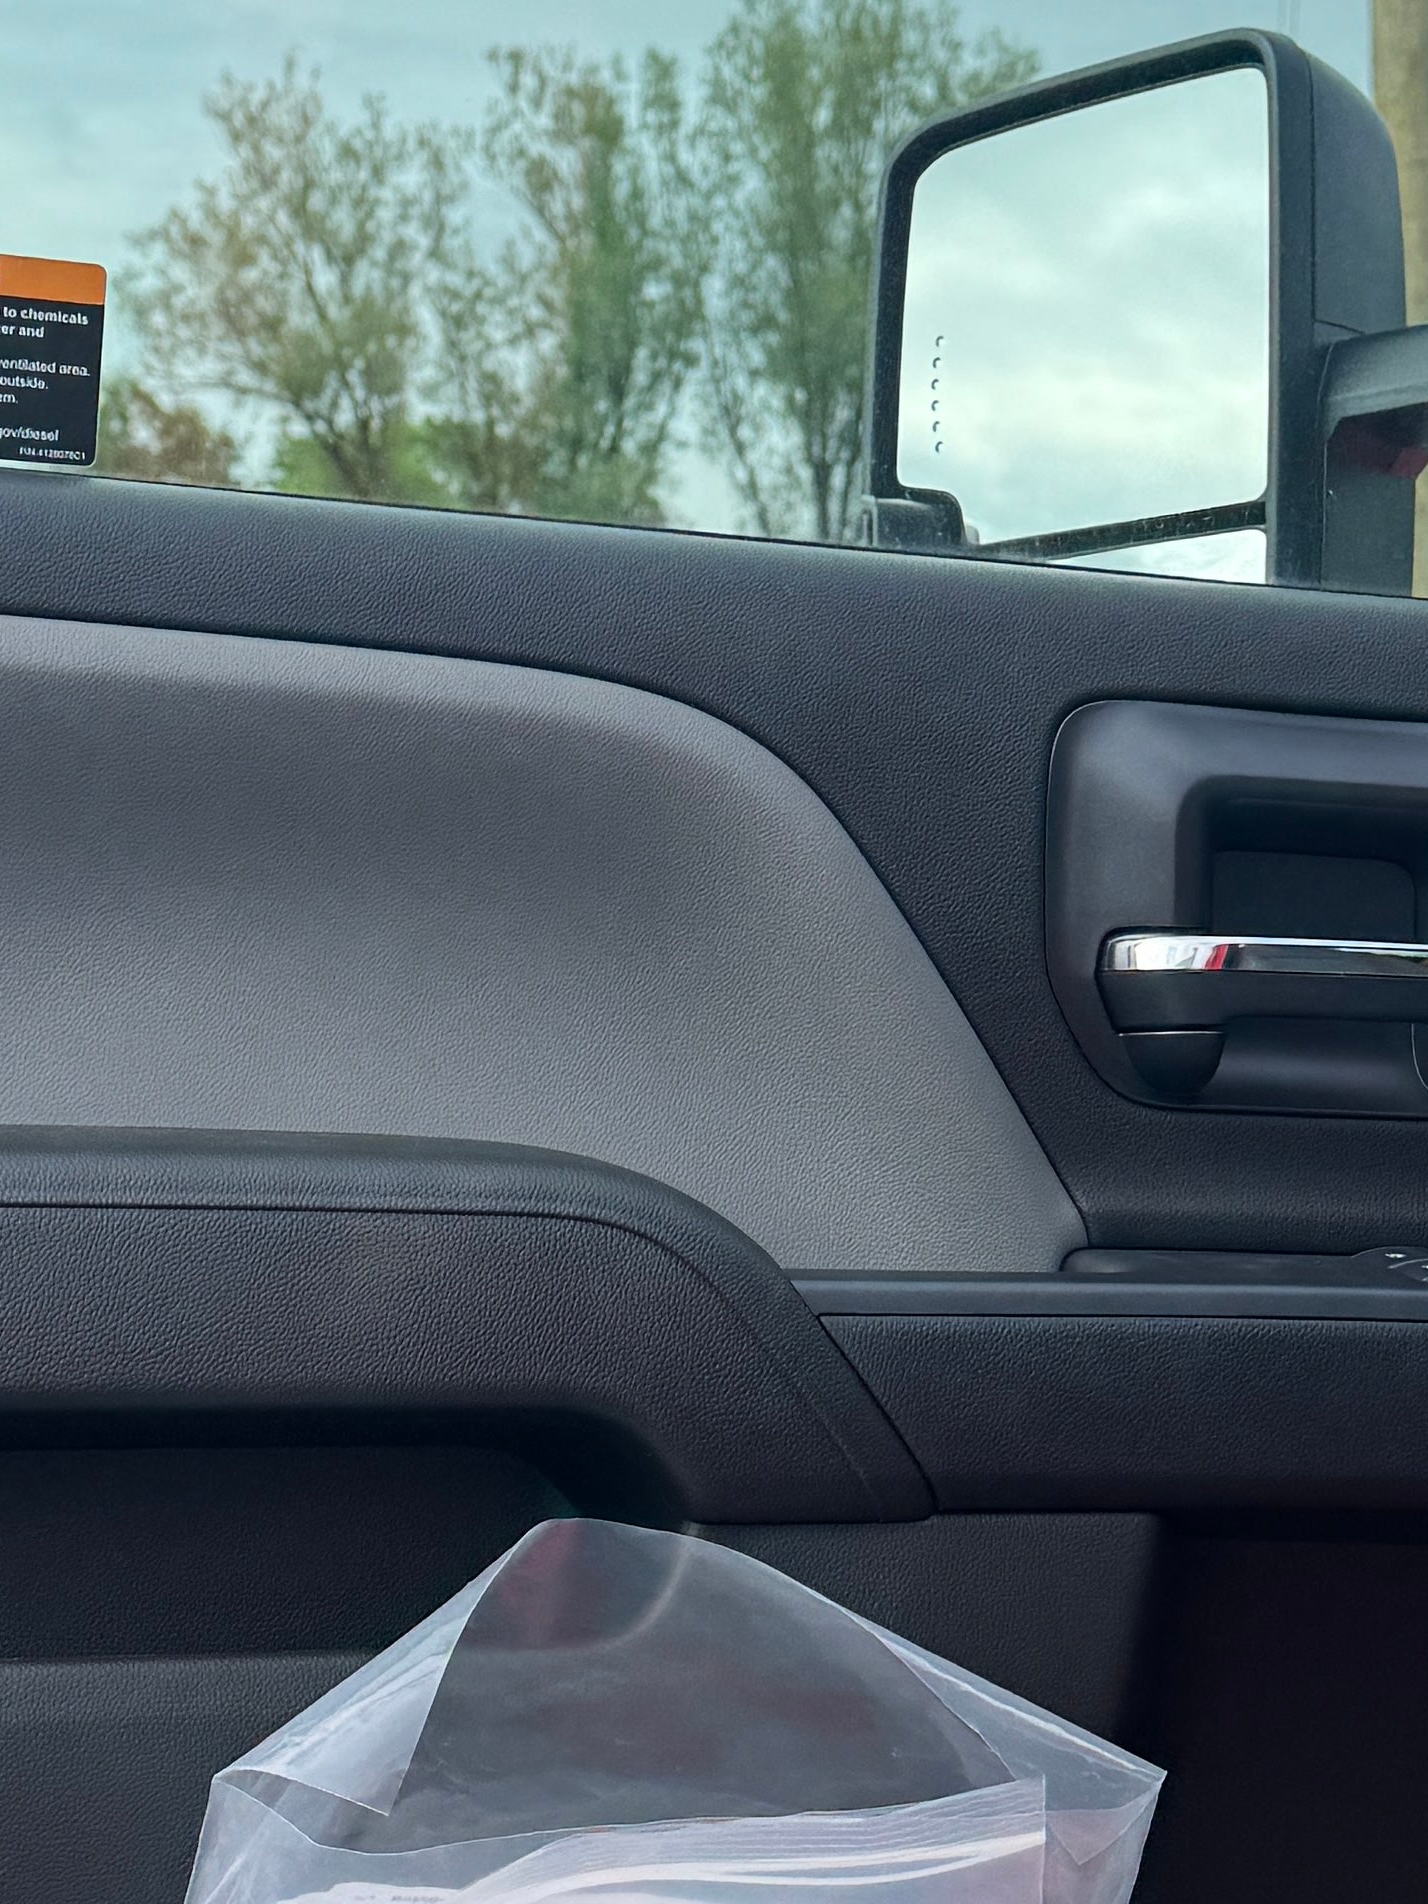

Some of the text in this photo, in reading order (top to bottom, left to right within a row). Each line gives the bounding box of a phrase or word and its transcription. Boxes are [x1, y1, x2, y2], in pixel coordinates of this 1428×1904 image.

[4, 306, 18, 318] to
[20, 308, 88, 326] chemicals
[18, 326, 44, 338] and
[59, 364, 91, 376] area.
[0, 374, 49, 390] outside.
